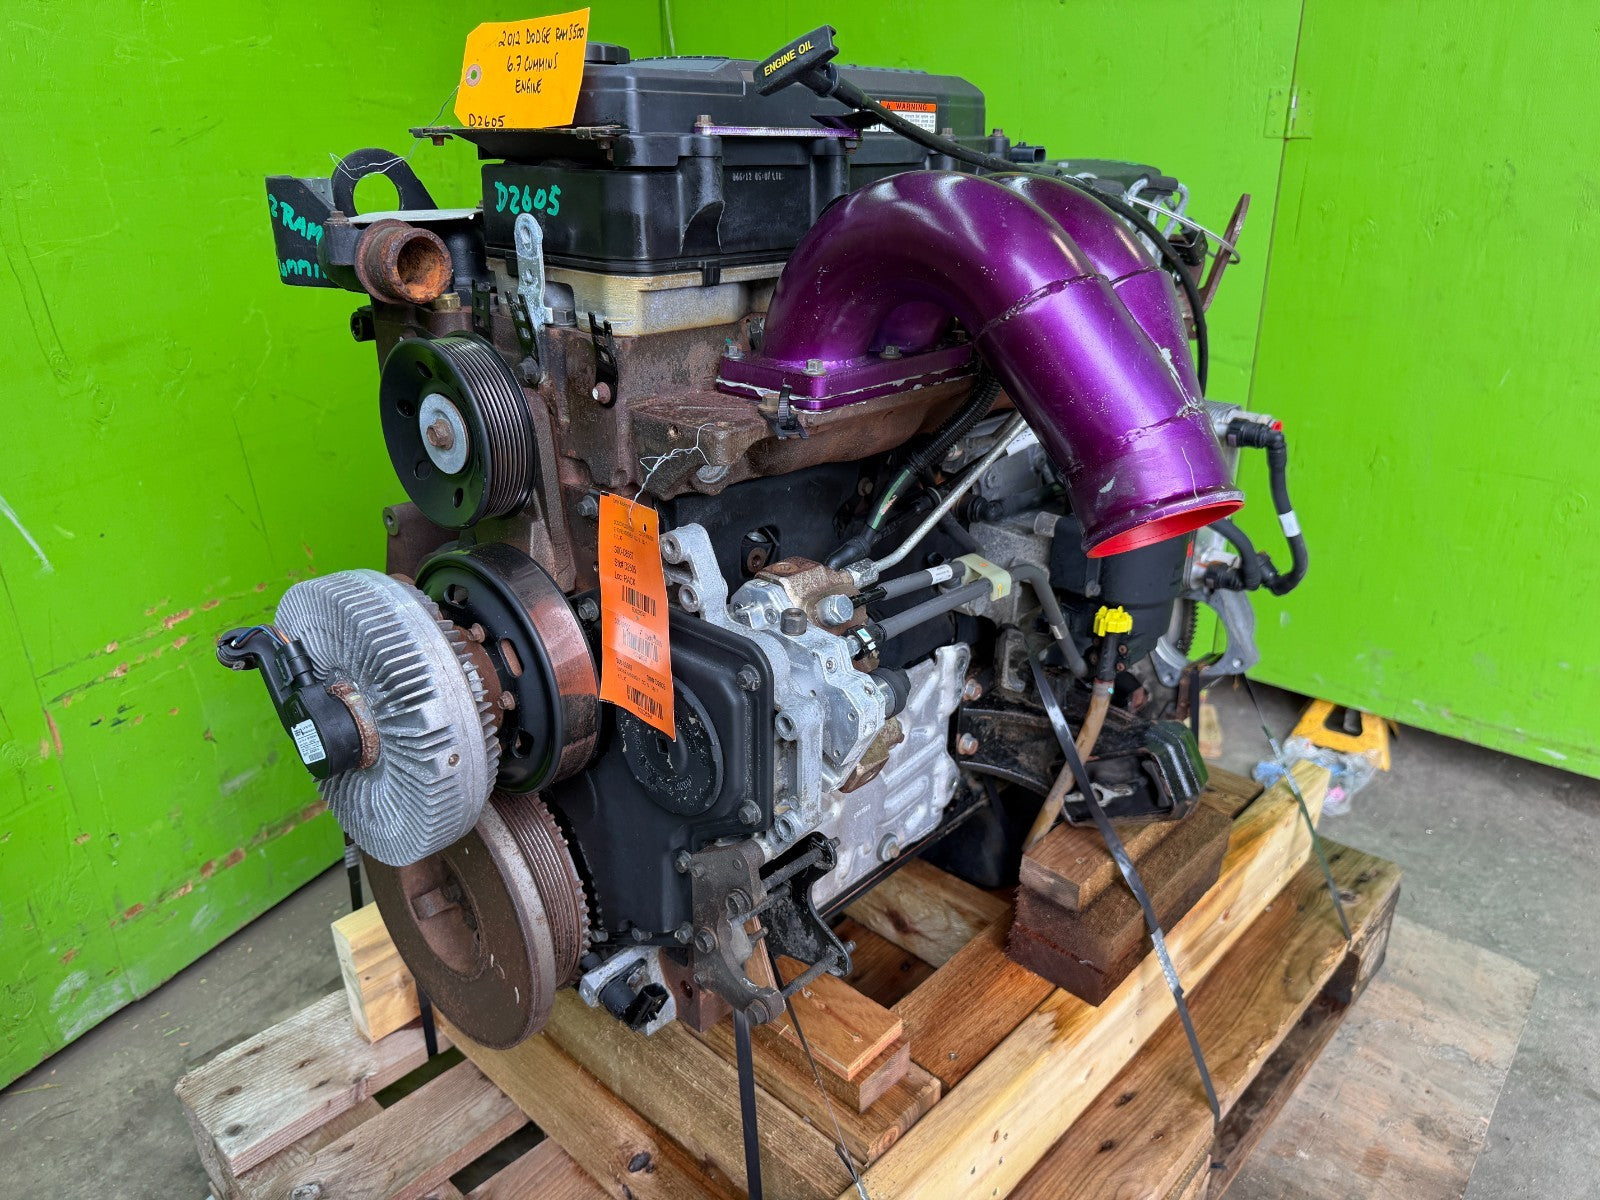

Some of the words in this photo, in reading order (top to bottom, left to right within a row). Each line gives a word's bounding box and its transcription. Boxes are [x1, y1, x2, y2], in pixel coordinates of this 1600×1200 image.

[498, 30, 521, 47] 2012
[526, 27, 552, 45] DODGE
[506, 55, 523, 72] 6.7
[524, 52, 560, 72] CUMMINS
[763, 49, 797, 77] ENGINE
[798, 40, 815, 56] OIL
[515, 78, 543, 94] ENGINE
[895, 102, 928, 111] WARNING
[468, 113, 506, 128] D2605
[494, 181, 562, 217] D2605
[280, 201, 324, 245] RAM
